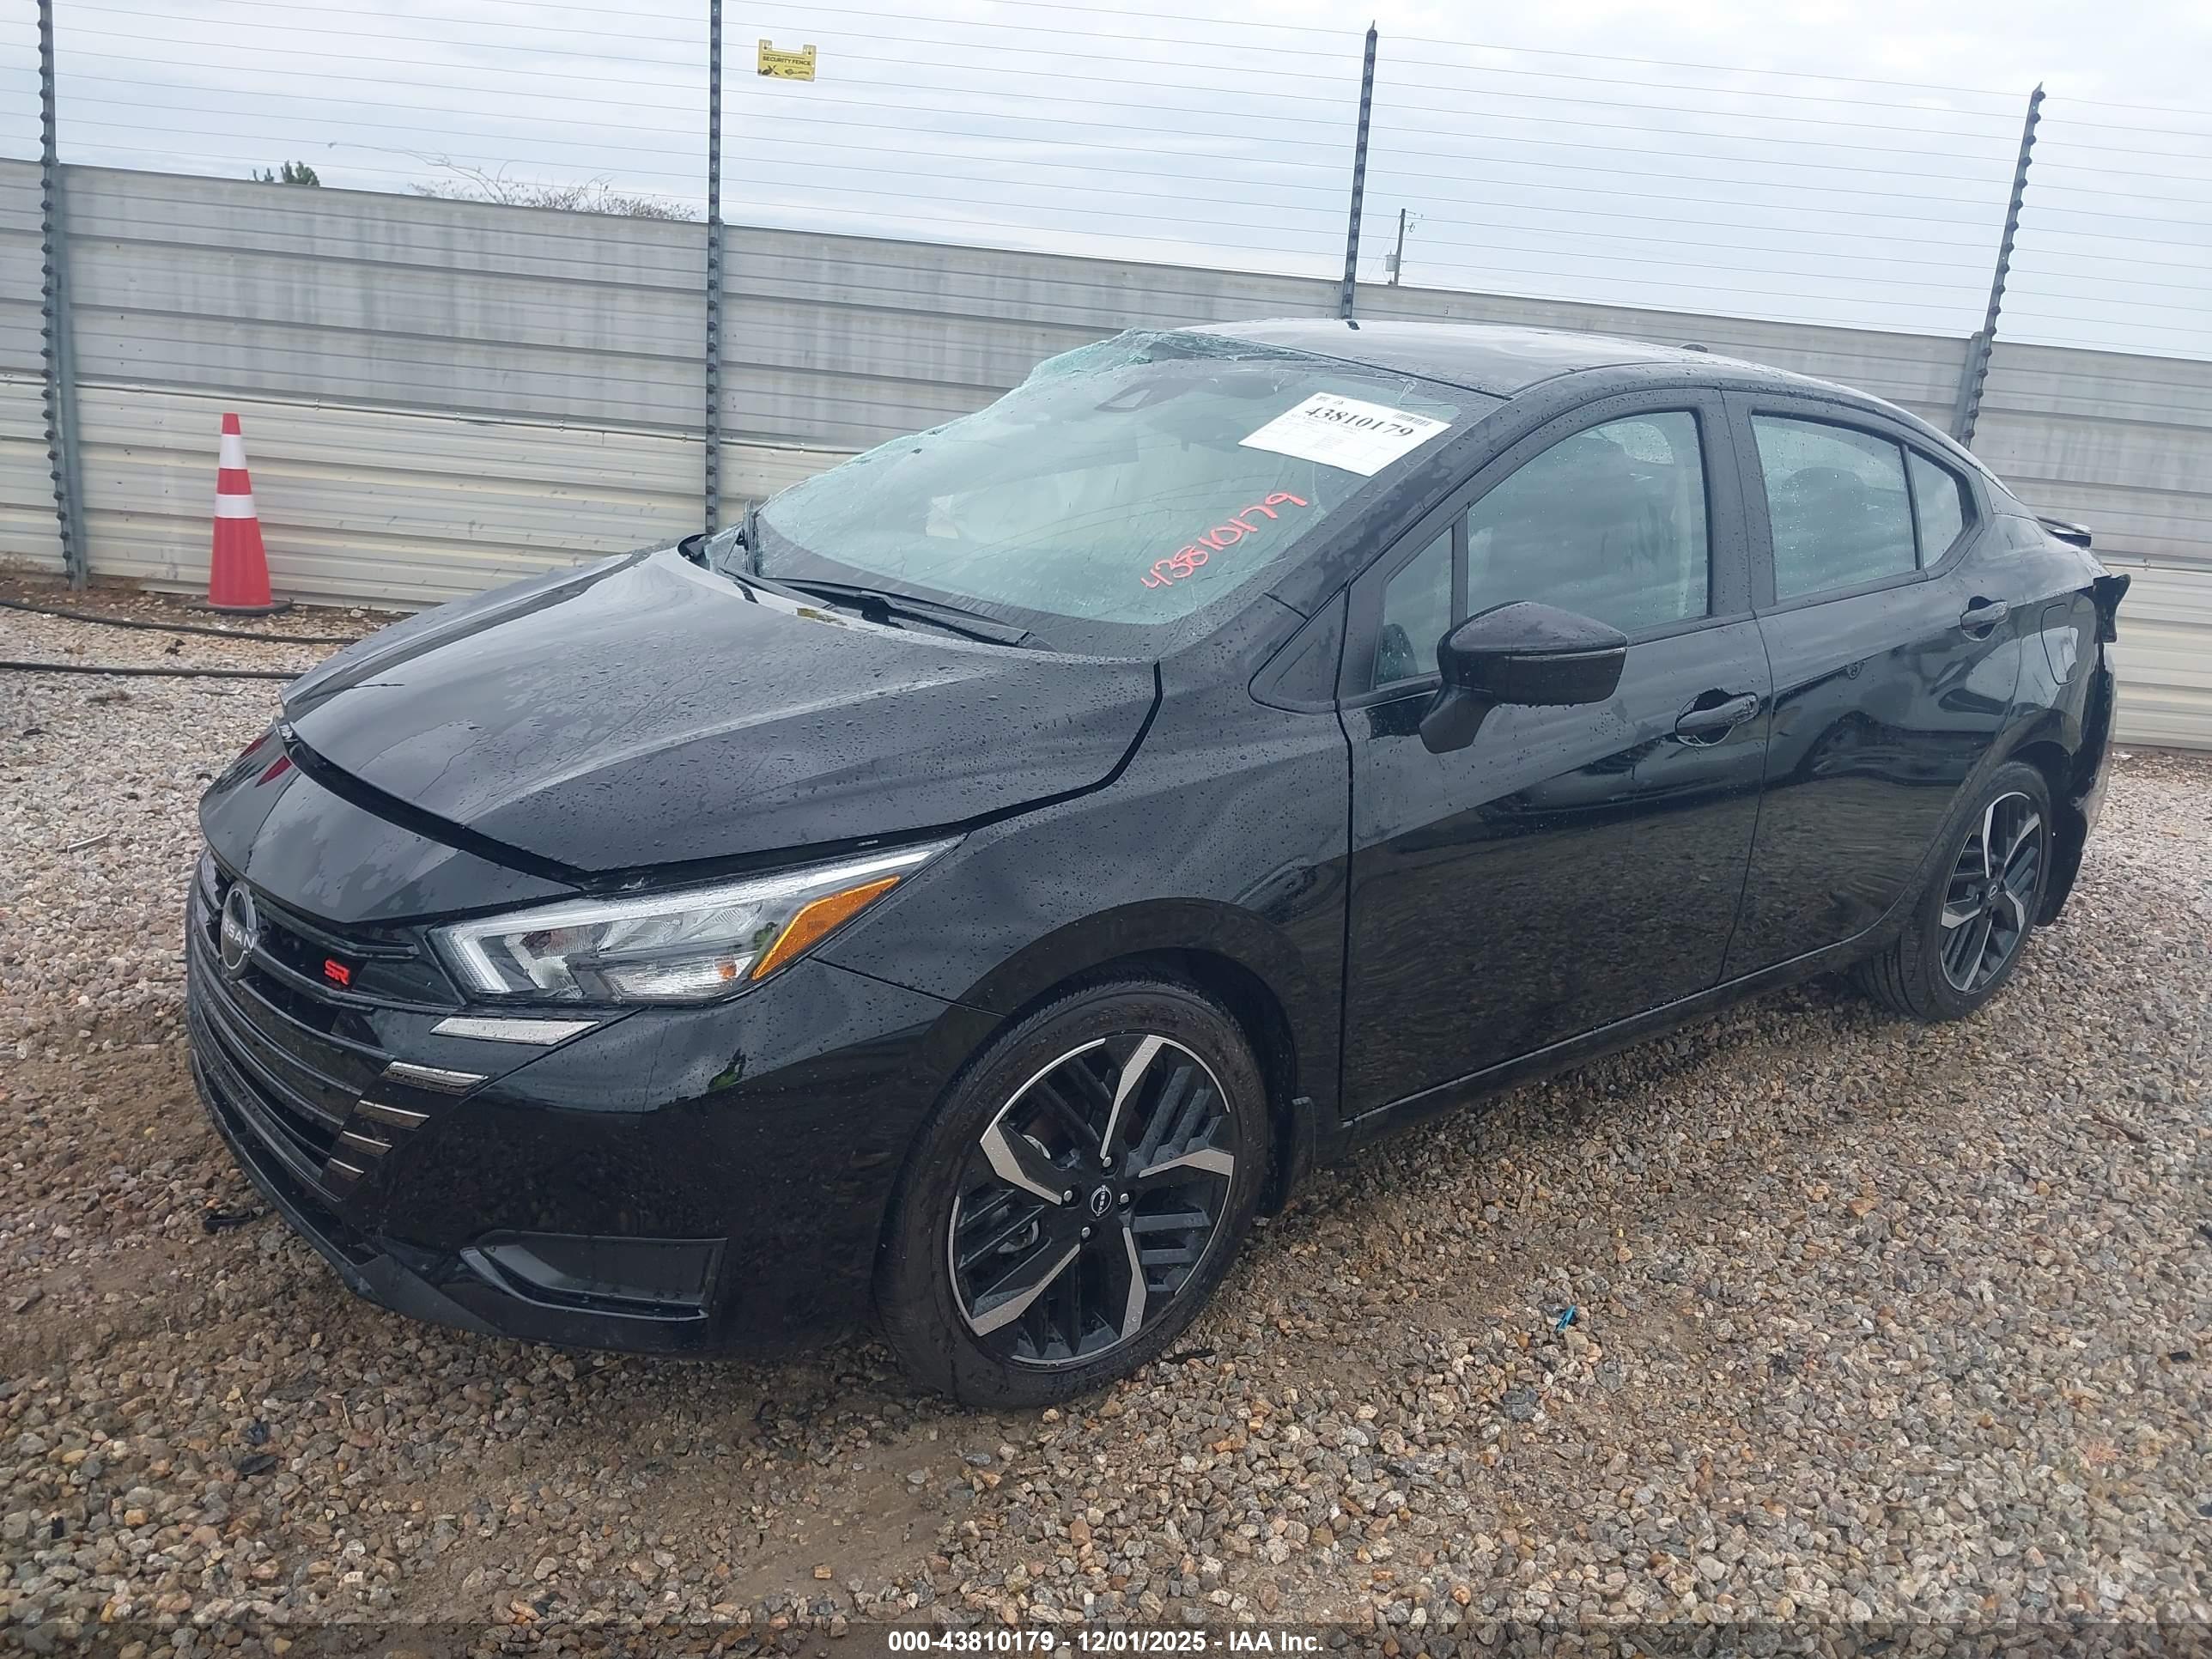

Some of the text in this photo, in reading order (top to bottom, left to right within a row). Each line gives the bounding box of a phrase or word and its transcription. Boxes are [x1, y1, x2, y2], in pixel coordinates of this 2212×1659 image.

[1304, 406, 1414, 437] 43810179
[1140, 492, 1308, 588] 43810179
[325, 959, 349, 986] SR
